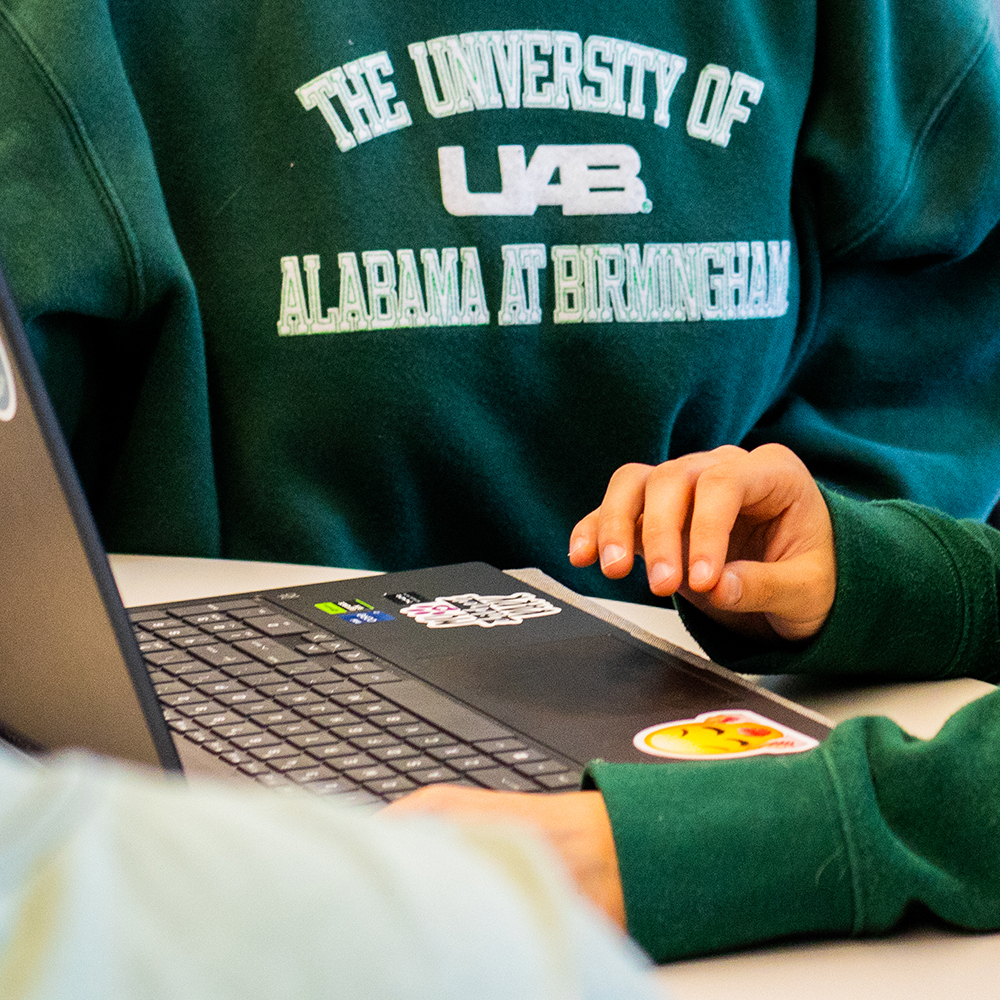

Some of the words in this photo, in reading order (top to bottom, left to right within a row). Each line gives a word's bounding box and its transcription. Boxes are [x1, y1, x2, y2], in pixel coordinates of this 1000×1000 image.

[295, 51, 412, 152] THE
[407, 30, 687, 128] UNIVERSITY
[686, 63, 764, 147] OF
[438, 144, 645, 216] UAB
[277, 247, 489, 336] ALABAMA
[498, 244, 546, 325] AT
[551, 241, 790, 323] BIRMINGHAM
